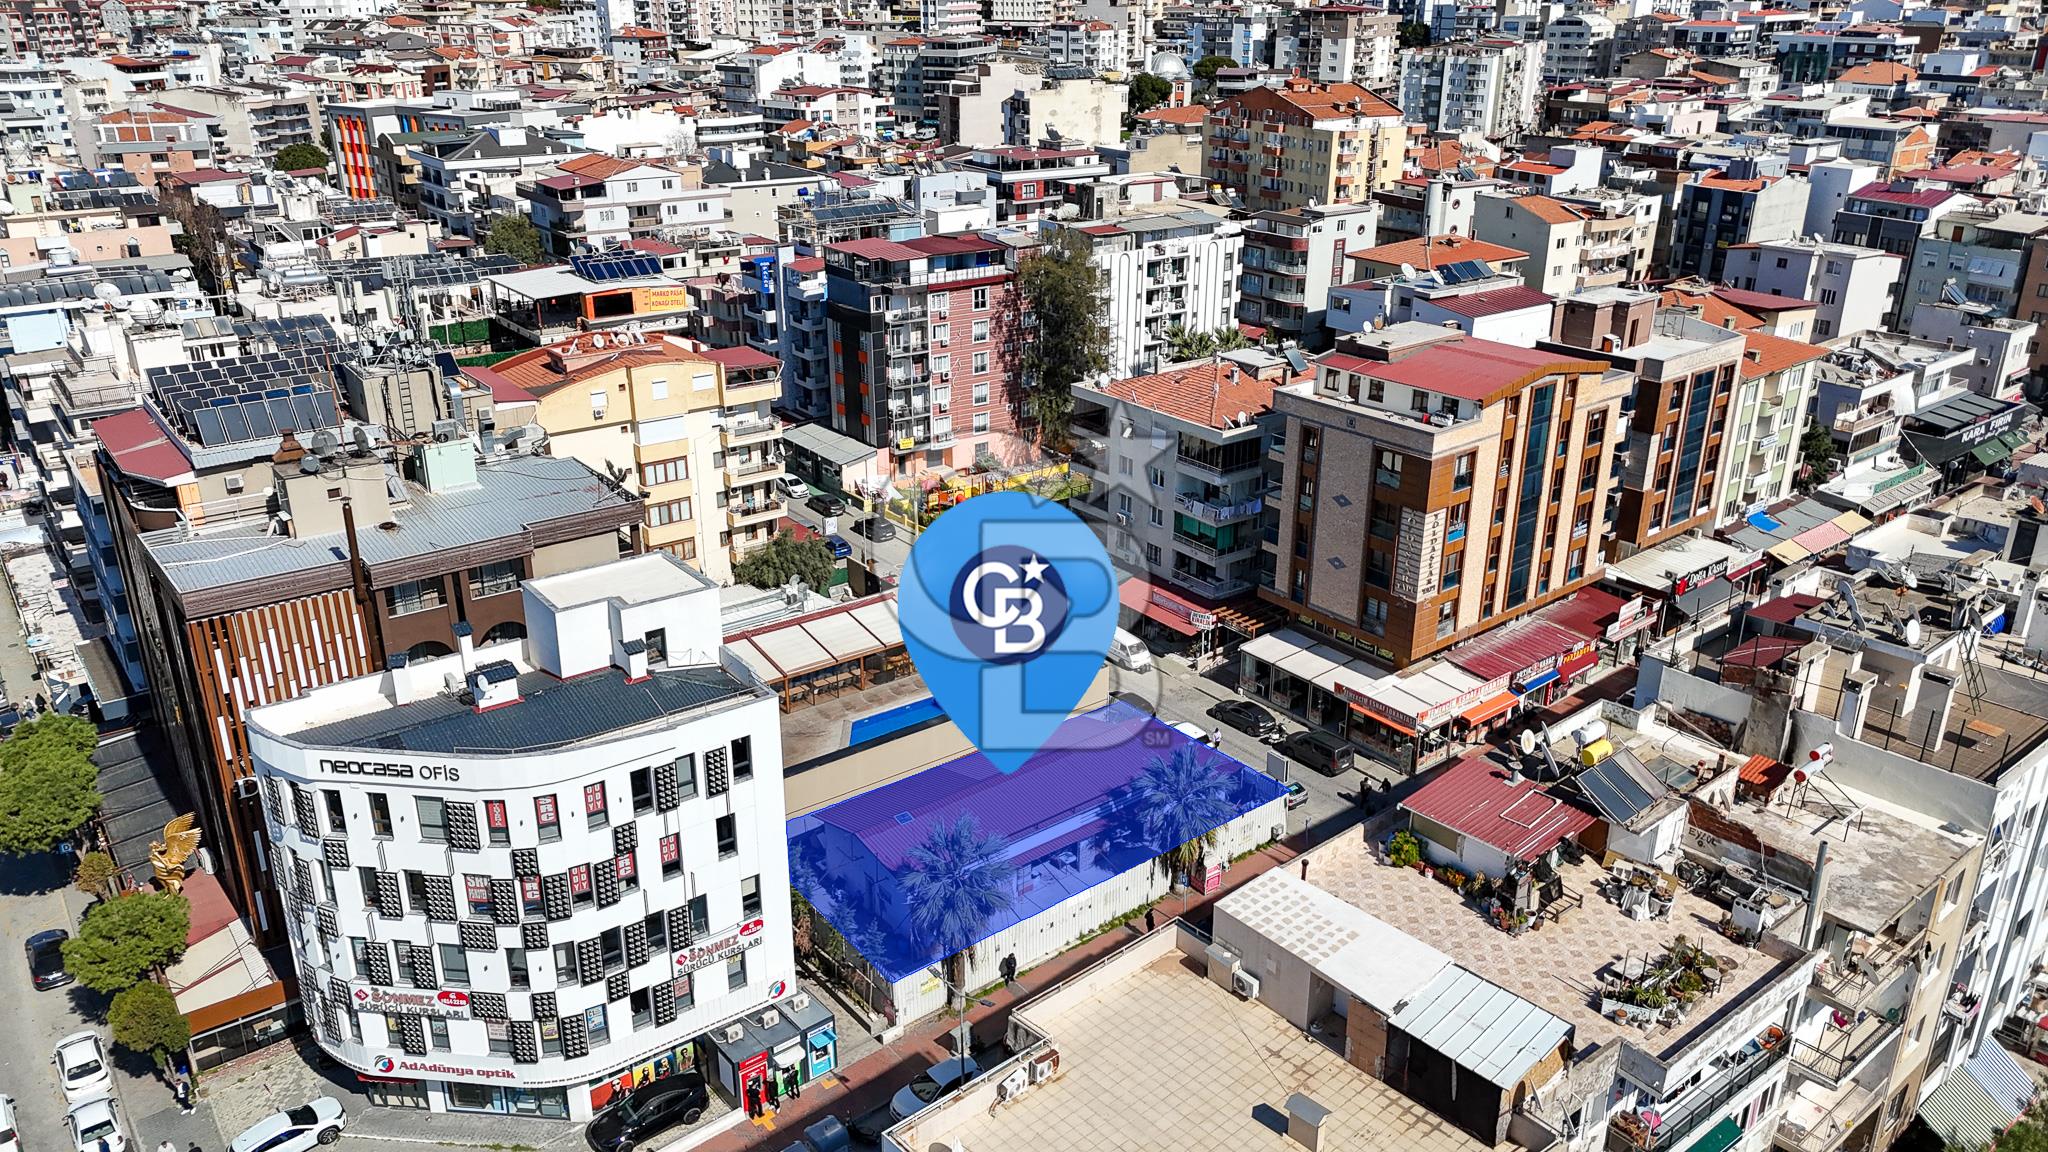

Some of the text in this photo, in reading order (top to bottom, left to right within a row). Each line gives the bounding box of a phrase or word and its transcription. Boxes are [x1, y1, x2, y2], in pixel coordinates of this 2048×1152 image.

[1961, 412, 2013, 443] KARA FIRIN
[320, 759, 460, 781] neocasa OFİS
[677, 936, 763, 977] SÜRÜCÜ KURSLARI
[688, 934, 740, 963] SÖNMEZ
[358, 1001, 467, 1020] SÜRÜCÜ KURSLARI
[399, 1060, 516, 1079] AdAdünya optik
